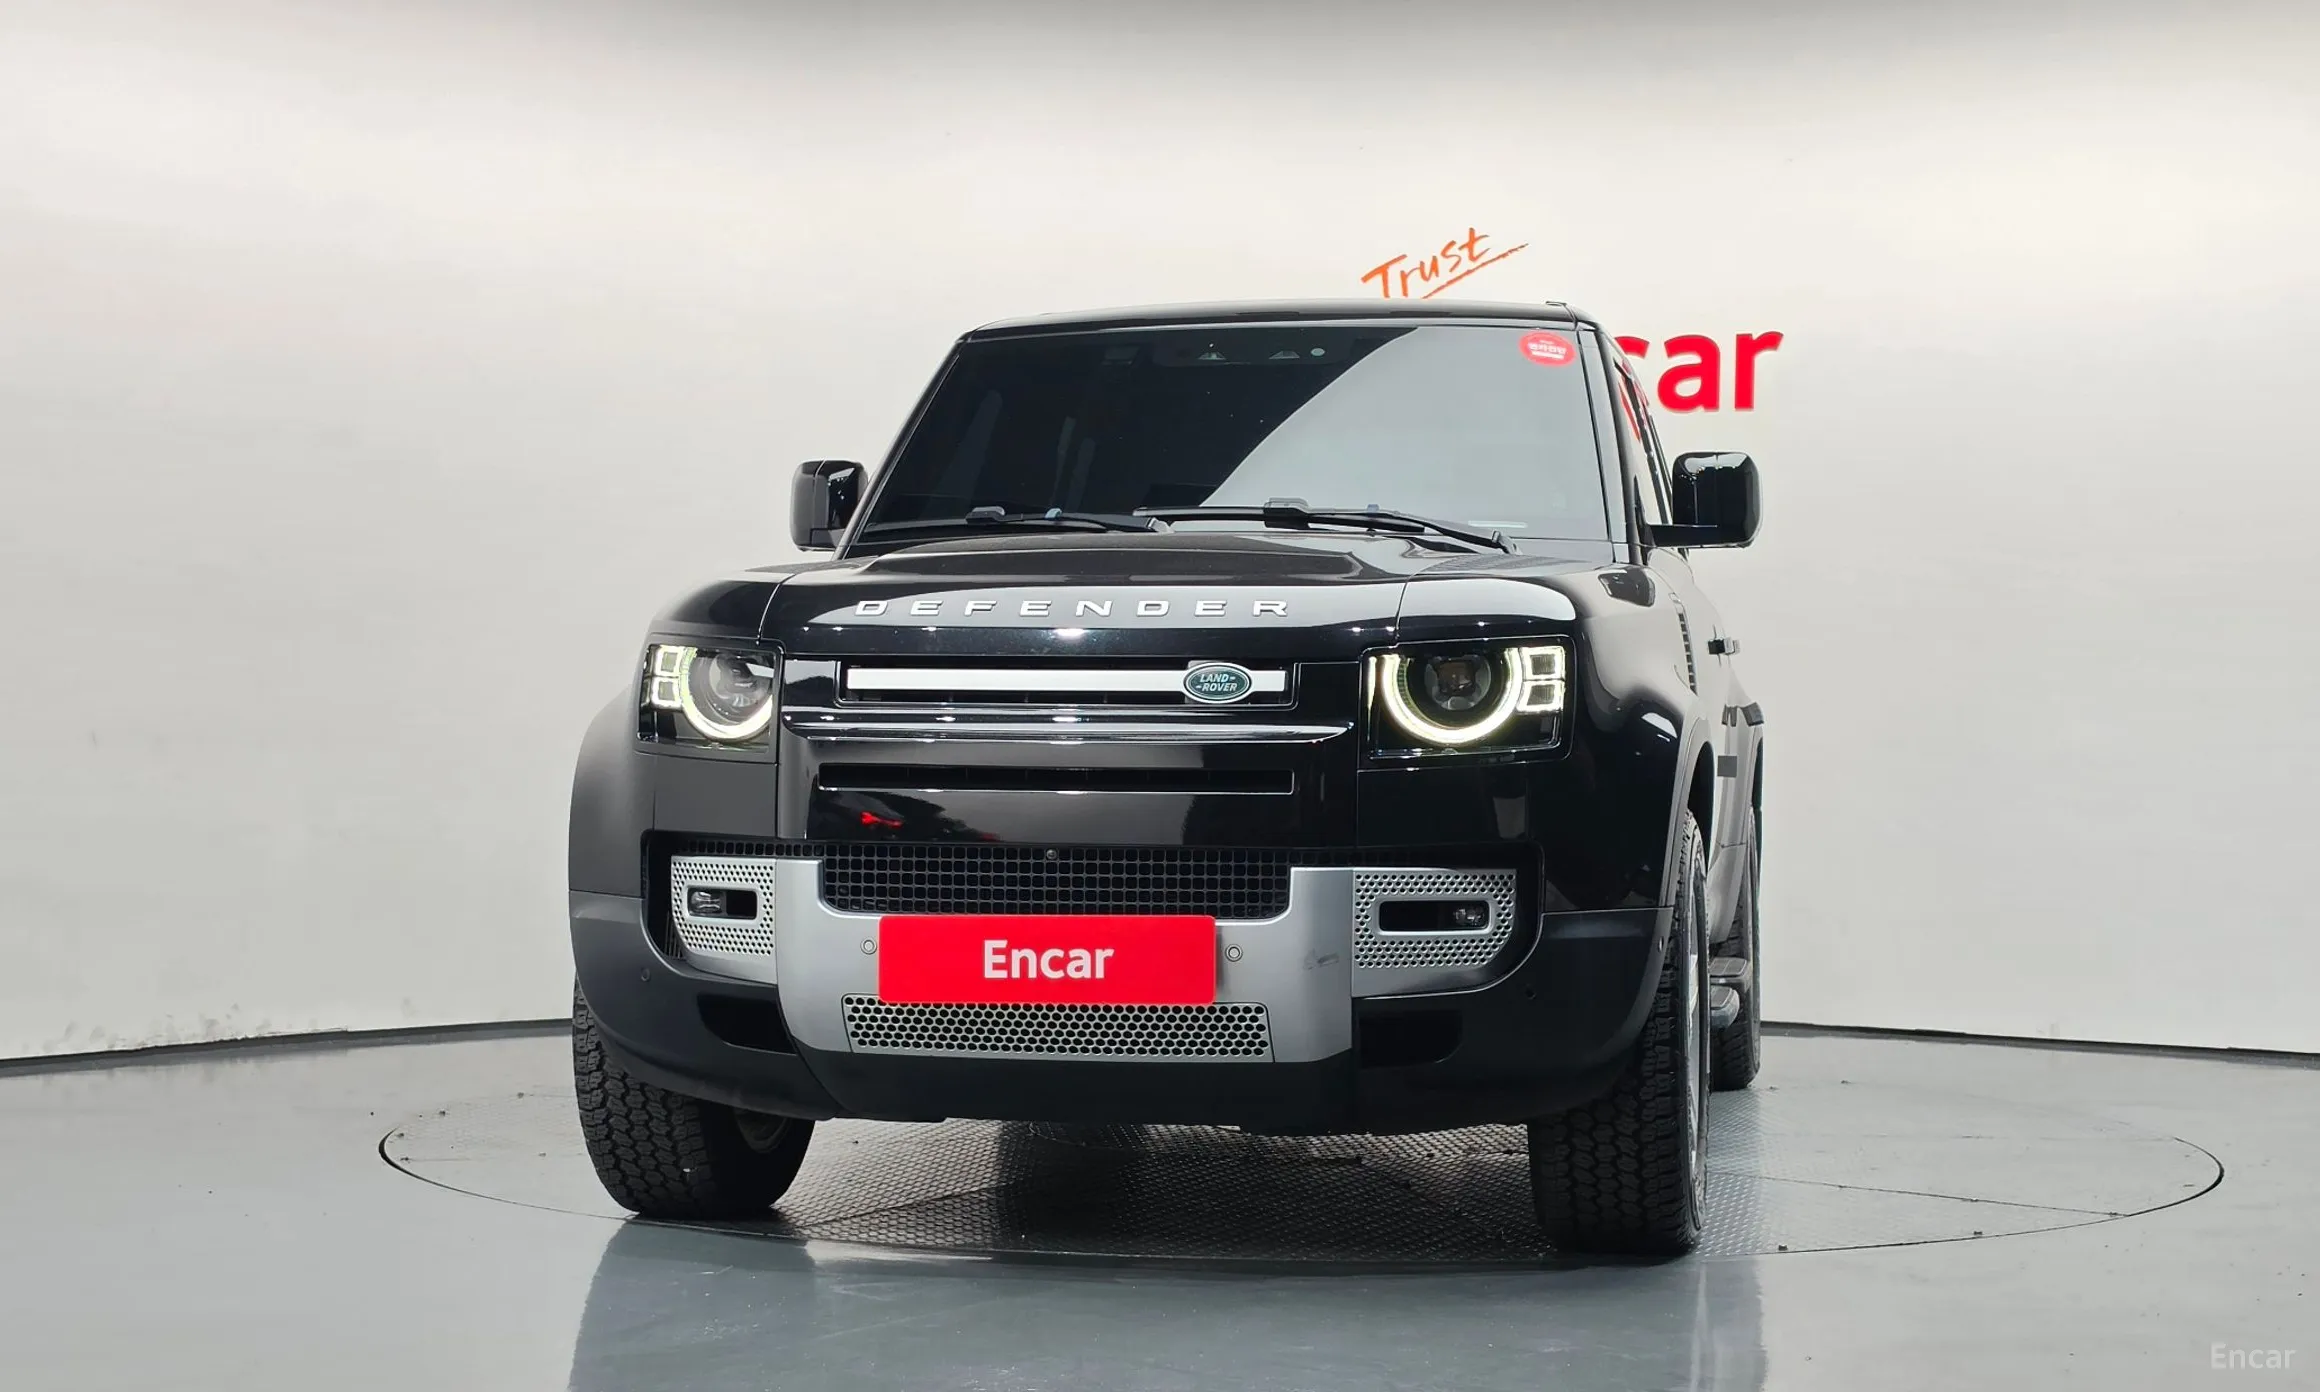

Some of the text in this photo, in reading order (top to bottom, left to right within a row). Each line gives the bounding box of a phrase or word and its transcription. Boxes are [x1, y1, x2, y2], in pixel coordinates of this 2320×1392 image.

[1361, 227, 1490, 299] Trust
[855, 600, 1288, 617] DEFENDER
[984, 939, 1115, 979] Encar
